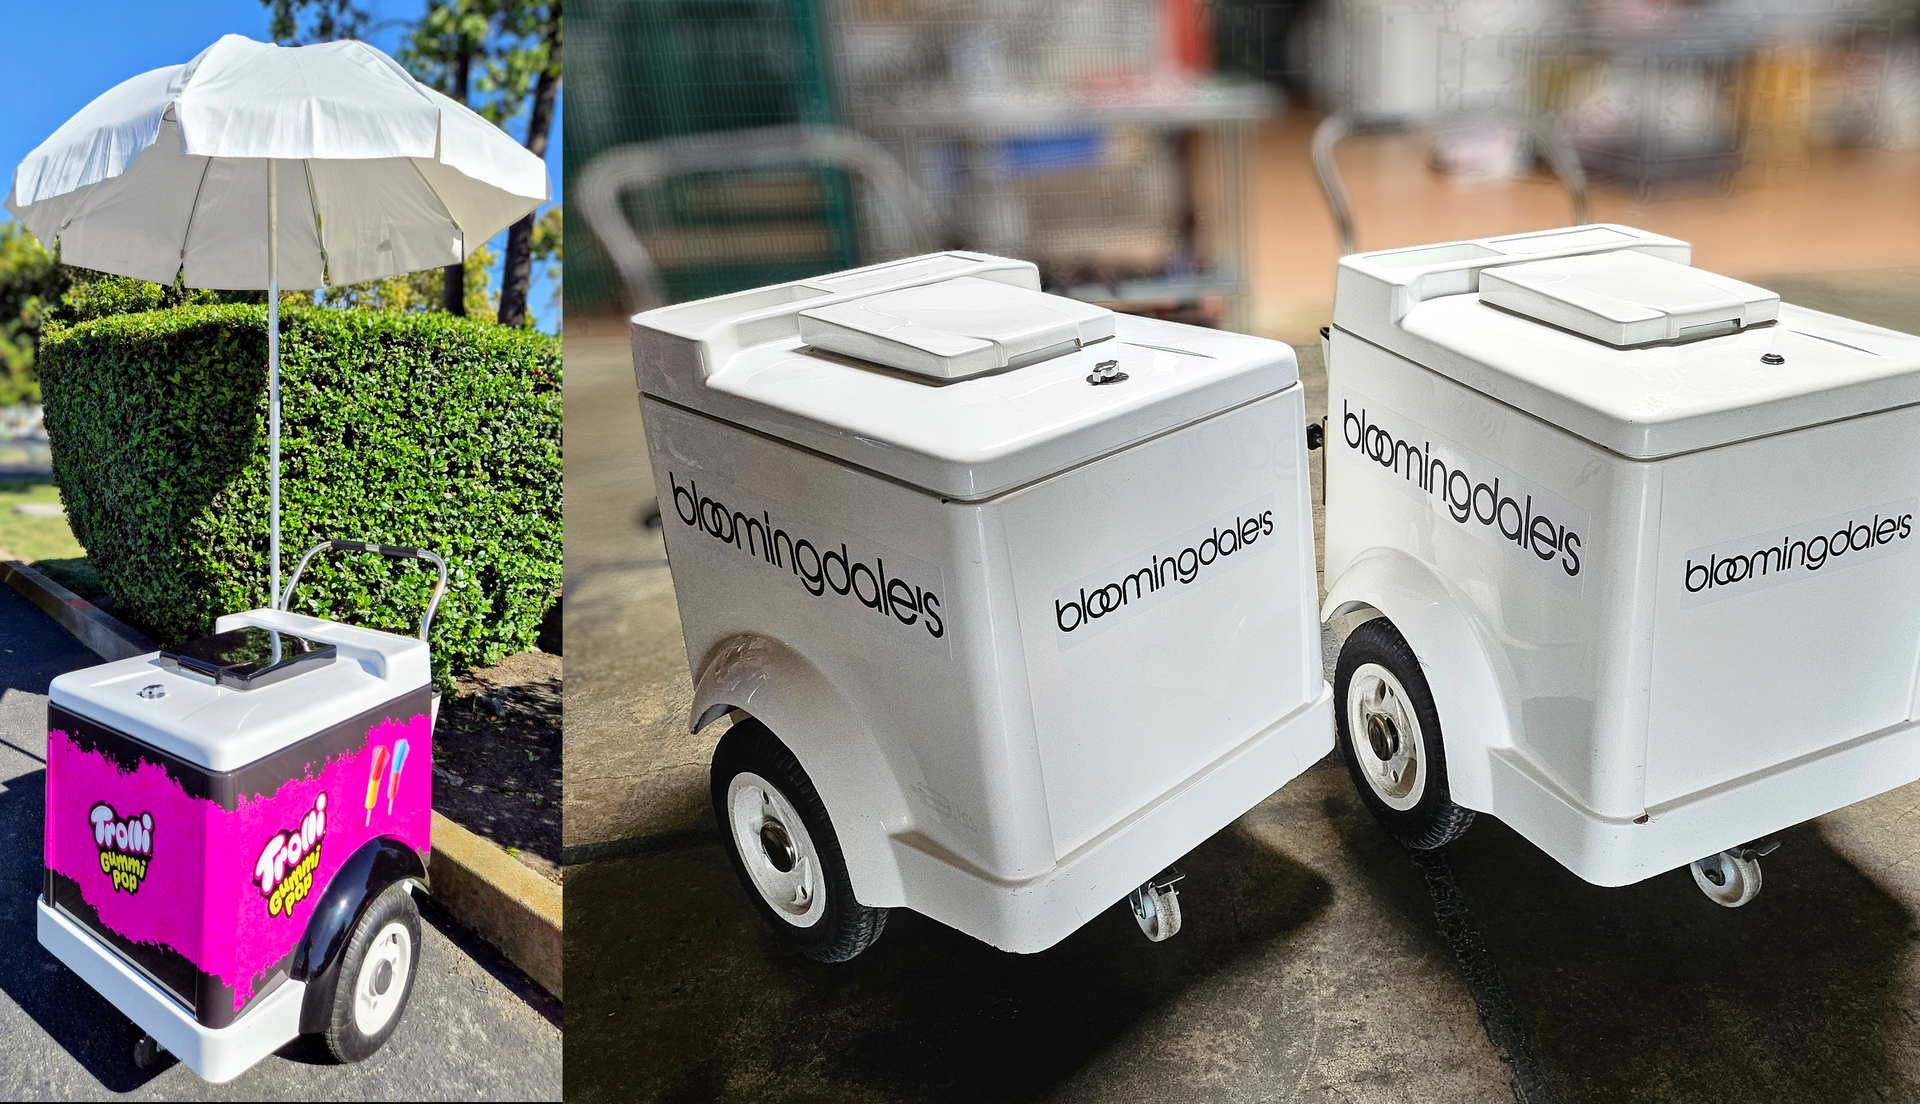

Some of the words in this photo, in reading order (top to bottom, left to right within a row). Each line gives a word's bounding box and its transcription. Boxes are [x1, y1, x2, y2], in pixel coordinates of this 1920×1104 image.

[1343, 398, 1582, 577] bloomingdale's
[669, 470, 944, 639] bloomingdale's
[1055, 510, 1274, 633] bloomingdale's
[1685, 513, 1913, 593] bloomingdale's
[90, 805, 152, 854] Trolli
[100, 851, 147, 879] Gummi
[255, 793, 326, 893] Trolli
[269, 844, 321, 915] Gummi
